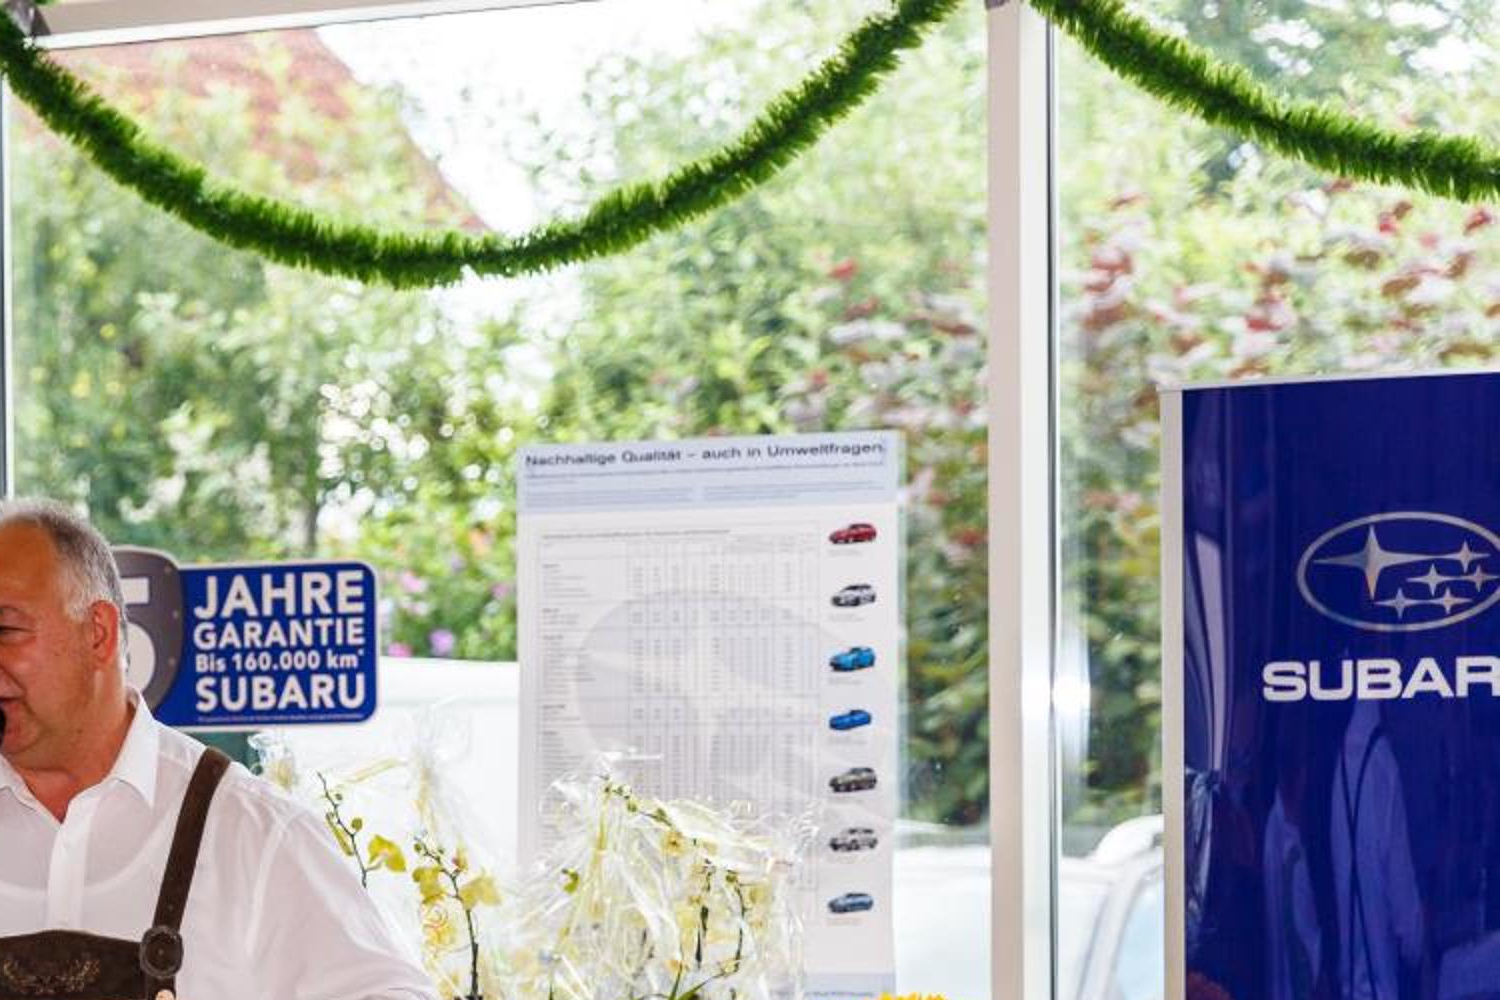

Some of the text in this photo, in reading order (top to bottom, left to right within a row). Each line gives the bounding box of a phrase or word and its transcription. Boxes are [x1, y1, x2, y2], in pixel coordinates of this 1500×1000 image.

[526, 454, 616, 466] Nachhaltige
[622, 450, 681, 463] Qualität
[702, 446, 741, 459] auch
[748, 446, 761, 457] in
[194, 569, 365, 619] JAHRE
[194, 617, 365, 650] GARANTIE
[195, 654, 226, 673] Bis
[234, 650, 320, 671] 160.000
[1262, 656, 1500, 701] SUBAR
[195, 673, 365, 712] SUBARU
